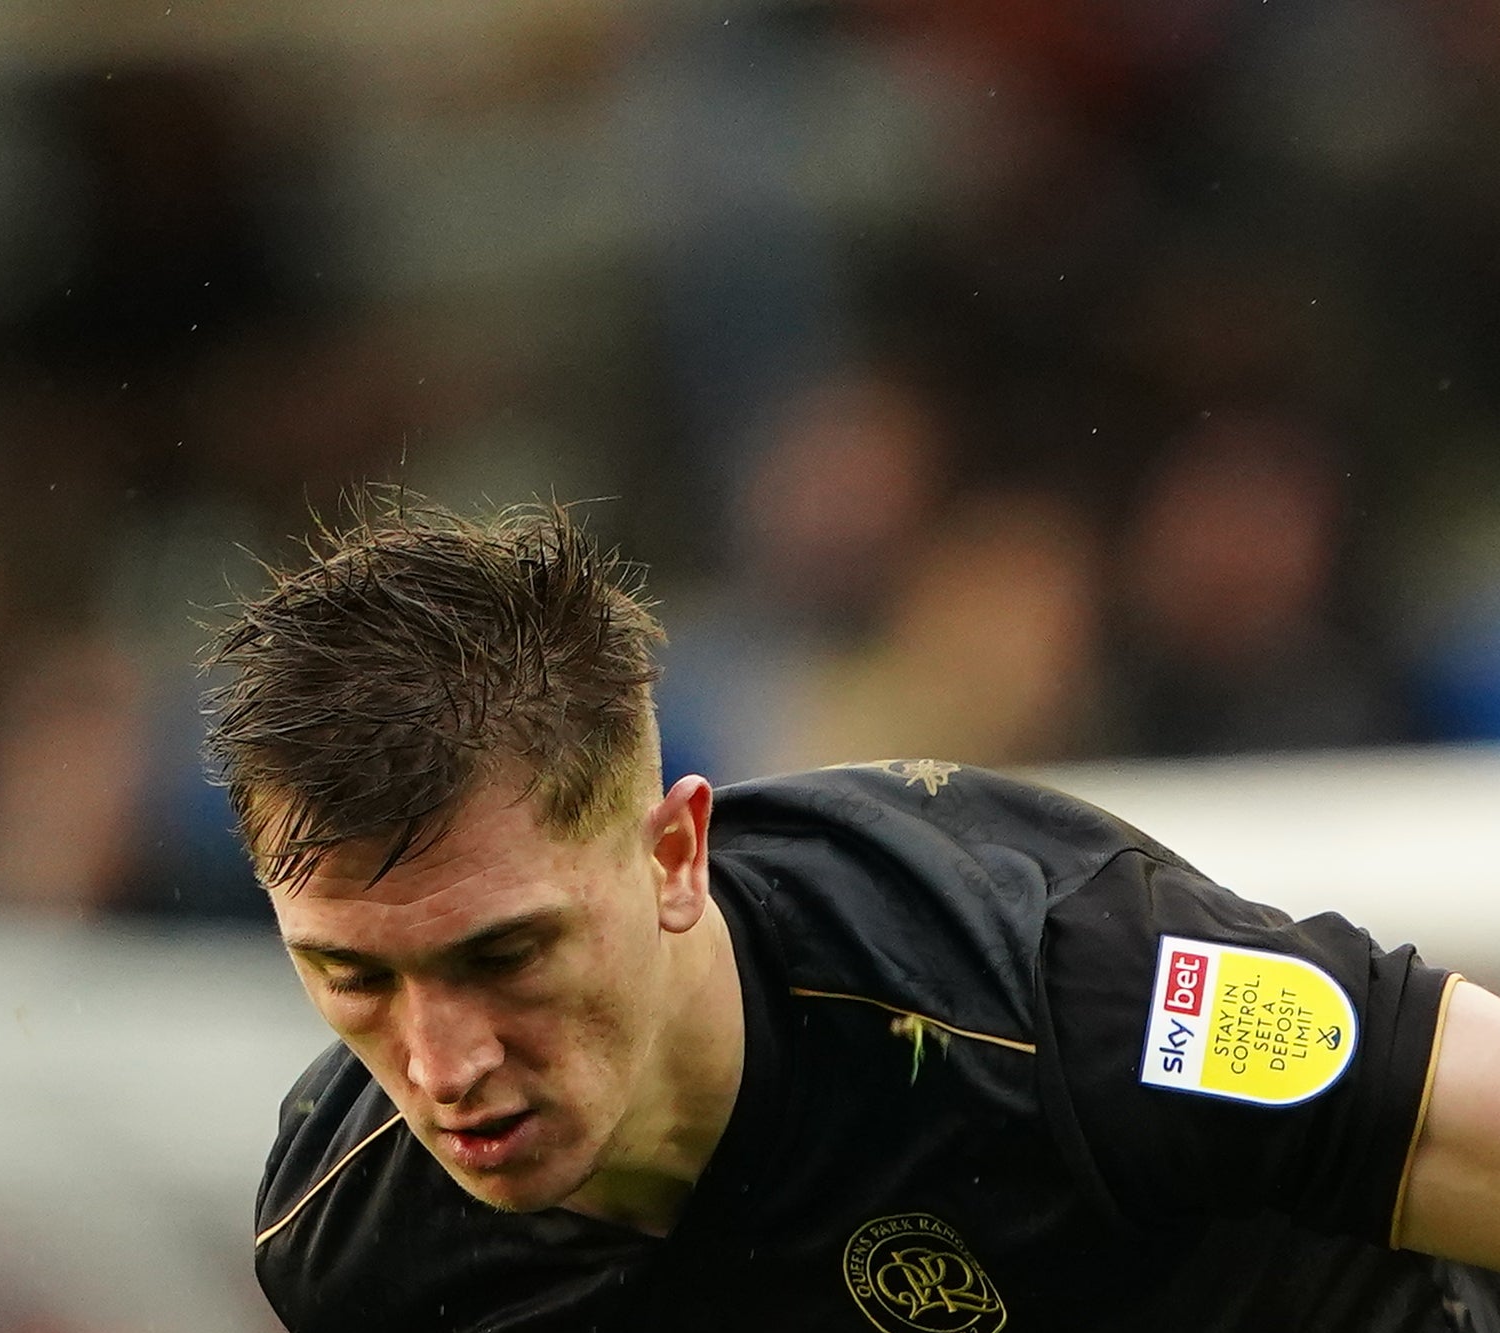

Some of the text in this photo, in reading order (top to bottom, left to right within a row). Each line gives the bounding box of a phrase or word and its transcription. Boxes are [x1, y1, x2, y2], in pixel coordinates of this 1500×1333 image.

[1159, 956, 1201, 1074] sky bet
[1214, 983, 1239, 1056] STAY IN
[1231, 974, 1261, 1075] CONTROL.
[1254, 1001, 1276, 1052] SET A
[1269, 988, 1297, 1071] DEPOSIT
[1291, 1006, 1313, 1059] LIMIT
[851, 1235, 874, 1298] QUEENS
[869, 1217, 914, 1239] PARK
